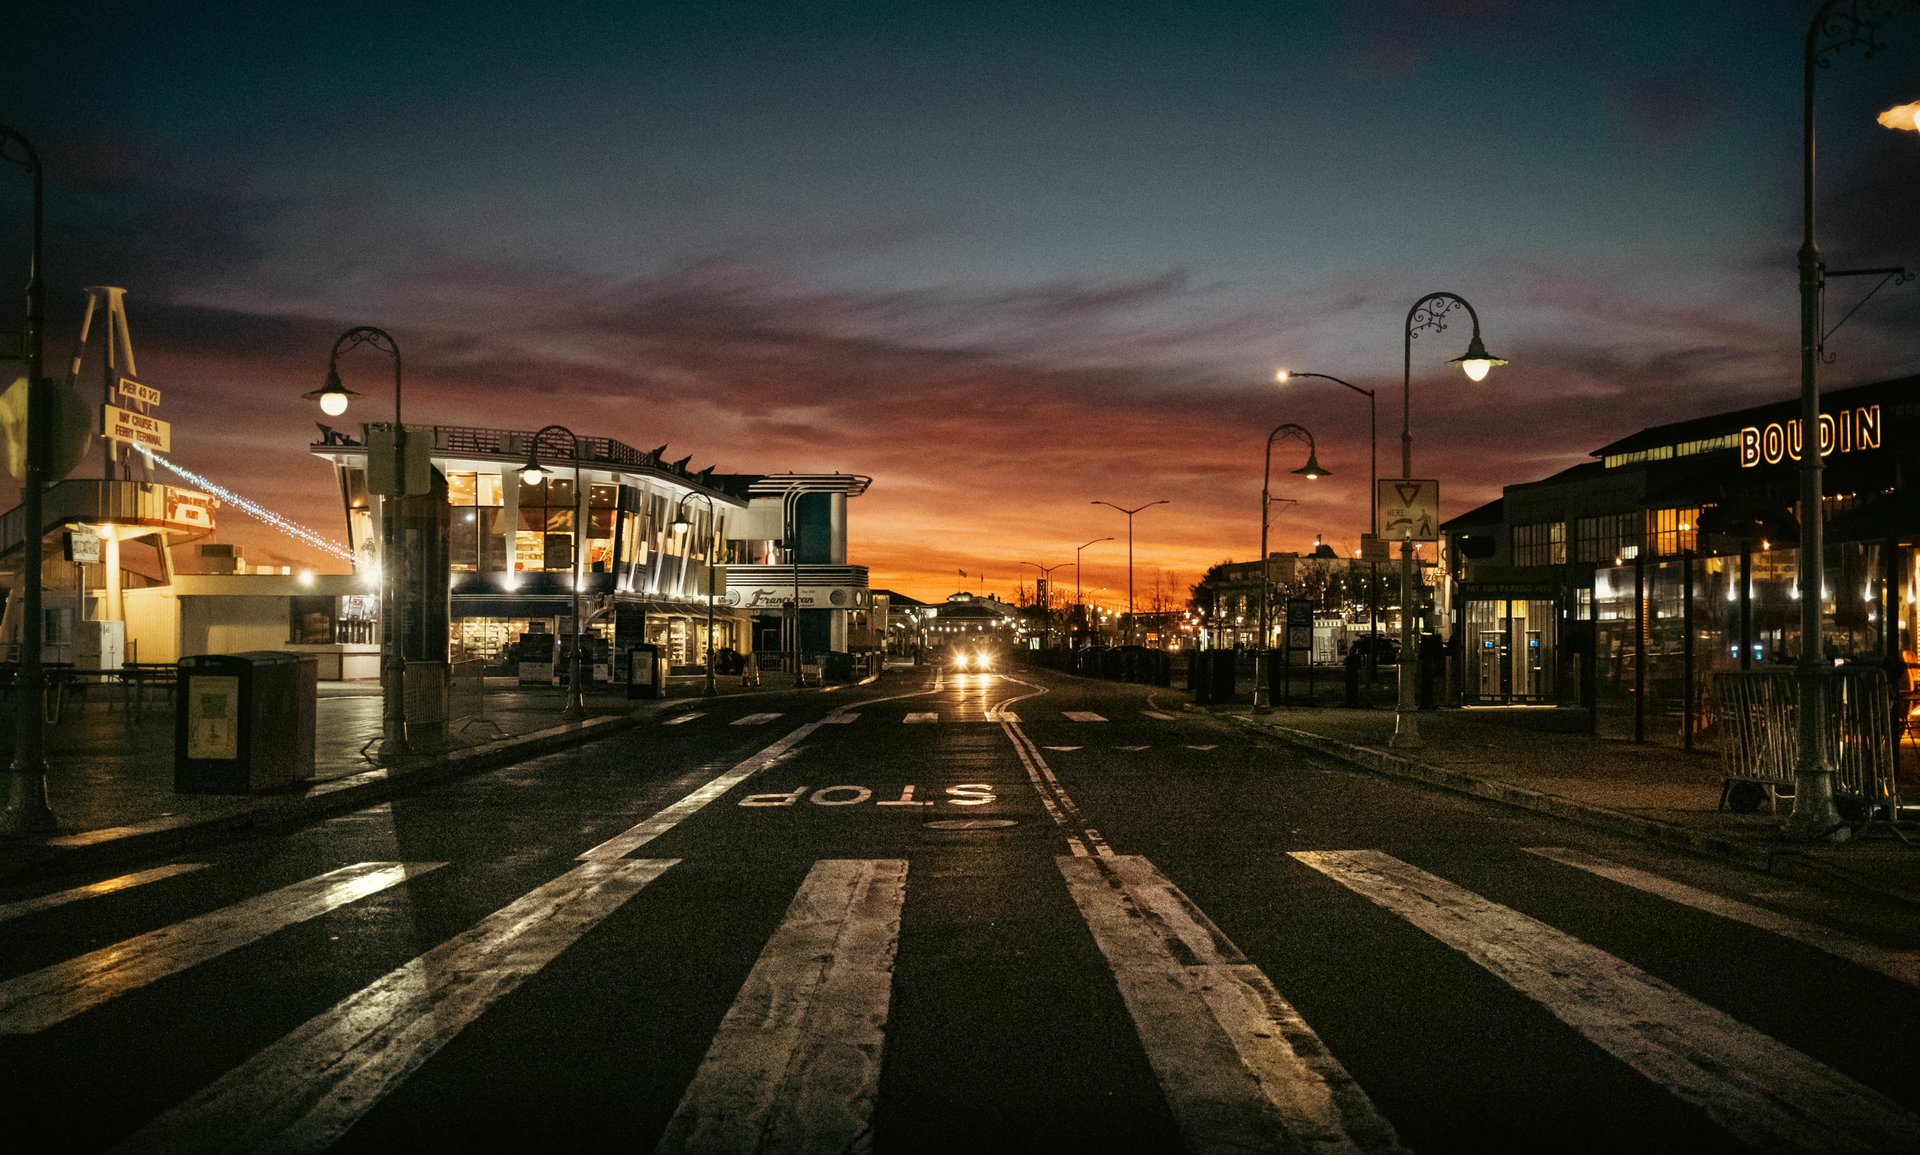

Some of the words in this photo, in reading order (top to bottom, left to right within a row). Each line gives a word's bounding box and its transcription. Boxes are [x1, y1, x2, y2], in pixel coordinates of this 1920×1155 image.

[122, 381, 137, 395] PIER
[138, 386, 147, 399] 43
[119, 411, 130, 424] BAY
[131, 415, 153, 431] CRUISE
[115, 424, 134, 439] FERRY
[135, 430, 162, 447] TERMINAL
[1740, 404, 1881, 468] BOUDIN
[1387, 508, 1405, 517] HERE
[738, 784, 996, 807] STOP
